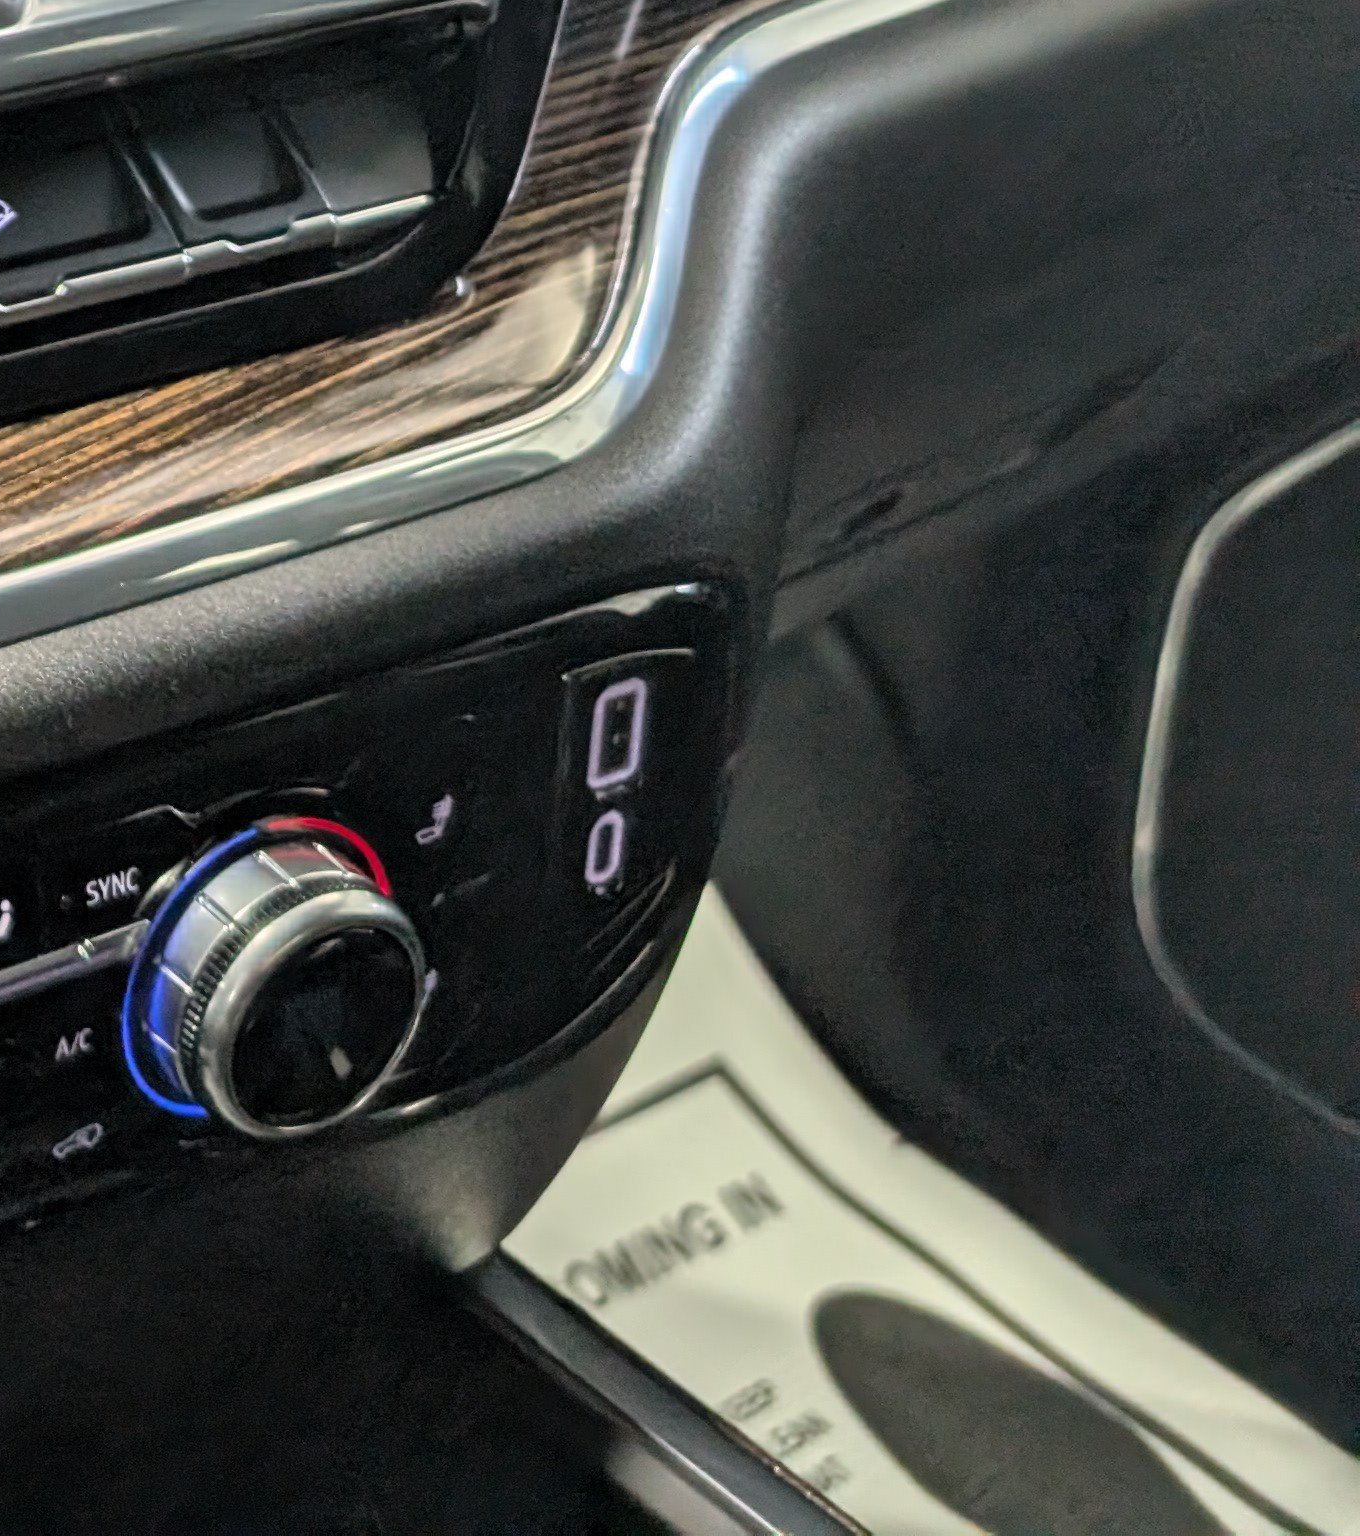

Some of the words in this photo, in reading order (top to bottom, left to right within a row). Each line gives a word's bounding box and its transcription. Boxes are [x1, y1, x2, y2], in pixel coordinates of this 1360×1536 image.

[86, 866, 140, 907] SYNC
[55, 1027, 93, 1062] A/C
[564, 1201, 726, 1306] OMING
